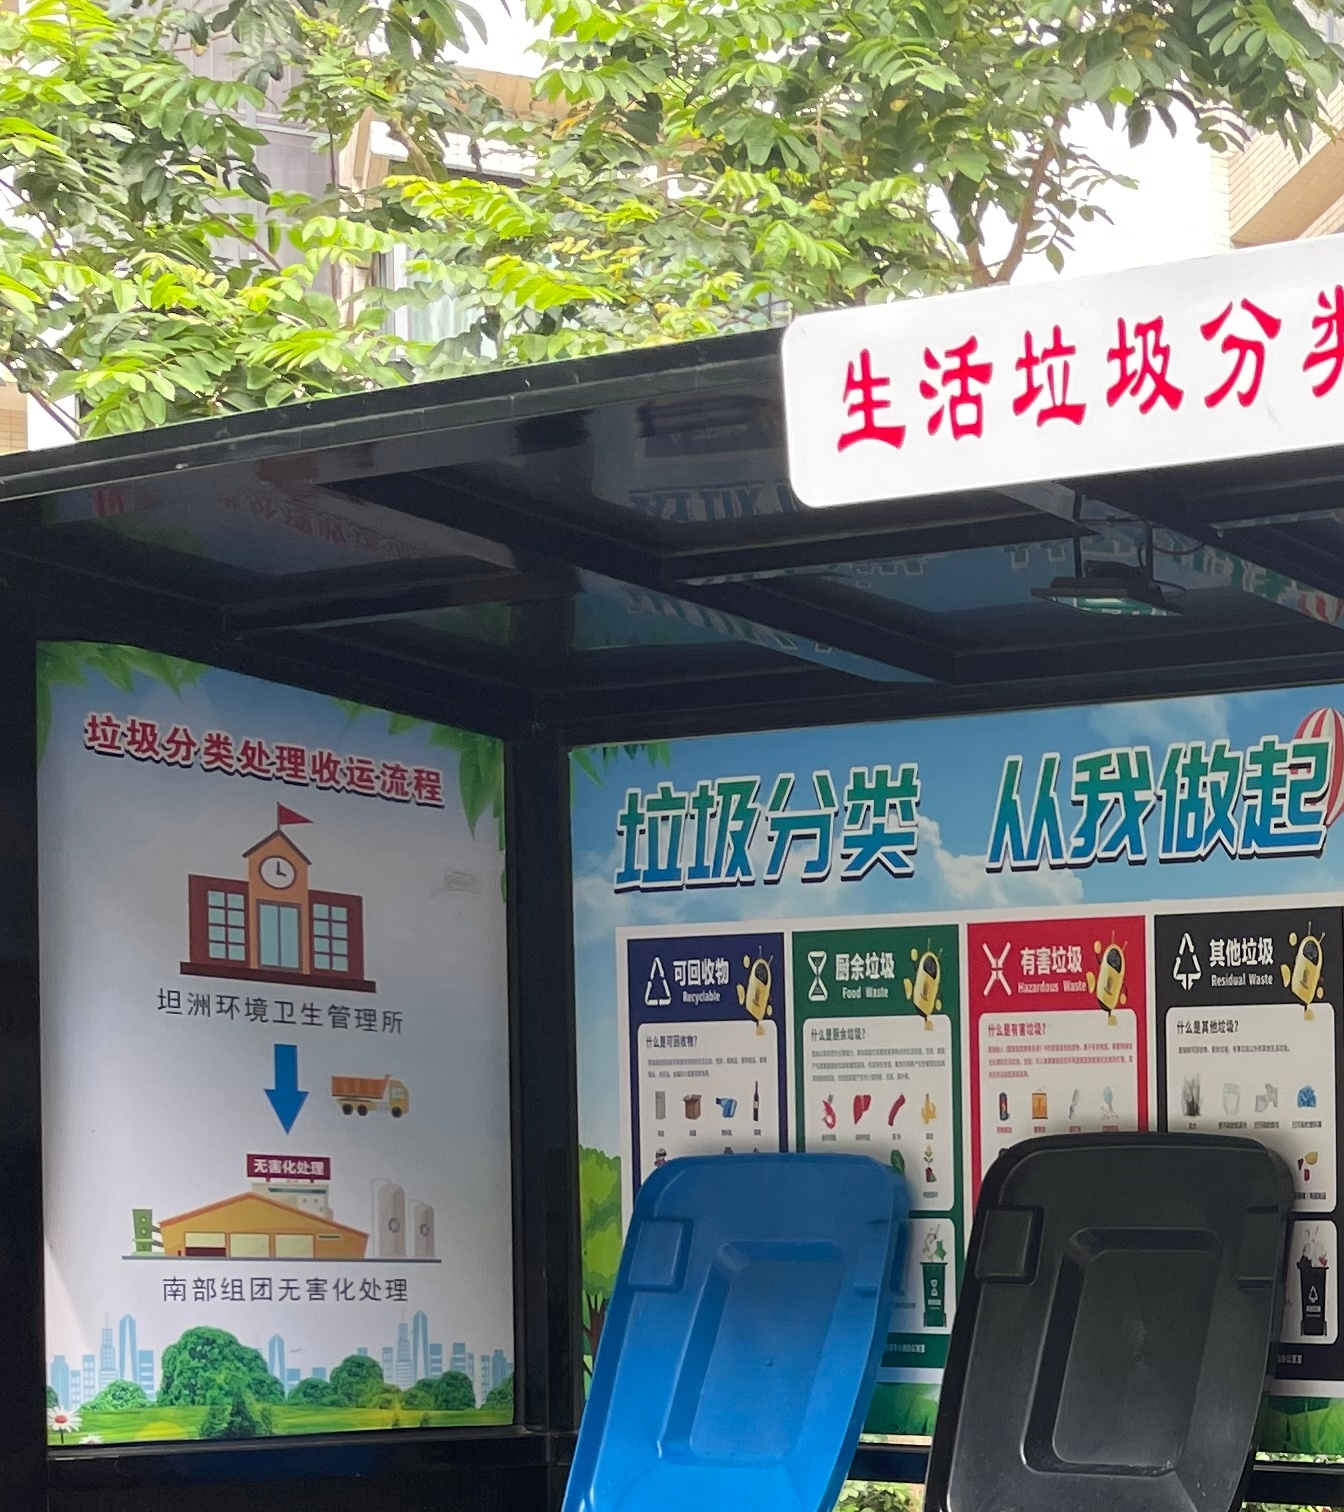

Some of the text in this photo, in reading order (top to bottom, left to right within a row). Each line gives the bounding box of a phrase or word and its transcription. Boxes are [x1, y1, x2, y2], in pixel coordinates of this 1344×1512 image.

[85, 713, 445, 805] 垃圾分类处理收运流程
[614, 734, 1334, 893] 垃圾分类 从我做起
[835, 952, 895, 982] 厨余垃圾
[1020, 946, 1083, 976] 有害垃圾
[1209, 937, 1274, 967] 其他垃圾
[673, 957, 729, 987] 可回收物
[1018, 979, 1087, 994] Hazardous Waste
[1211, 973, 1273, 987] Residual Waste
[683, 991, 721, 1005] Recyclable
[842, 986, 889, 999] Food Waste
[156, 987, 404, 1037] 坦洲环境卫生管理所
[253, 1158, 325, 1176] 无害化处理
[162, 1275, 409, 1304] 南部组团无害化处理
